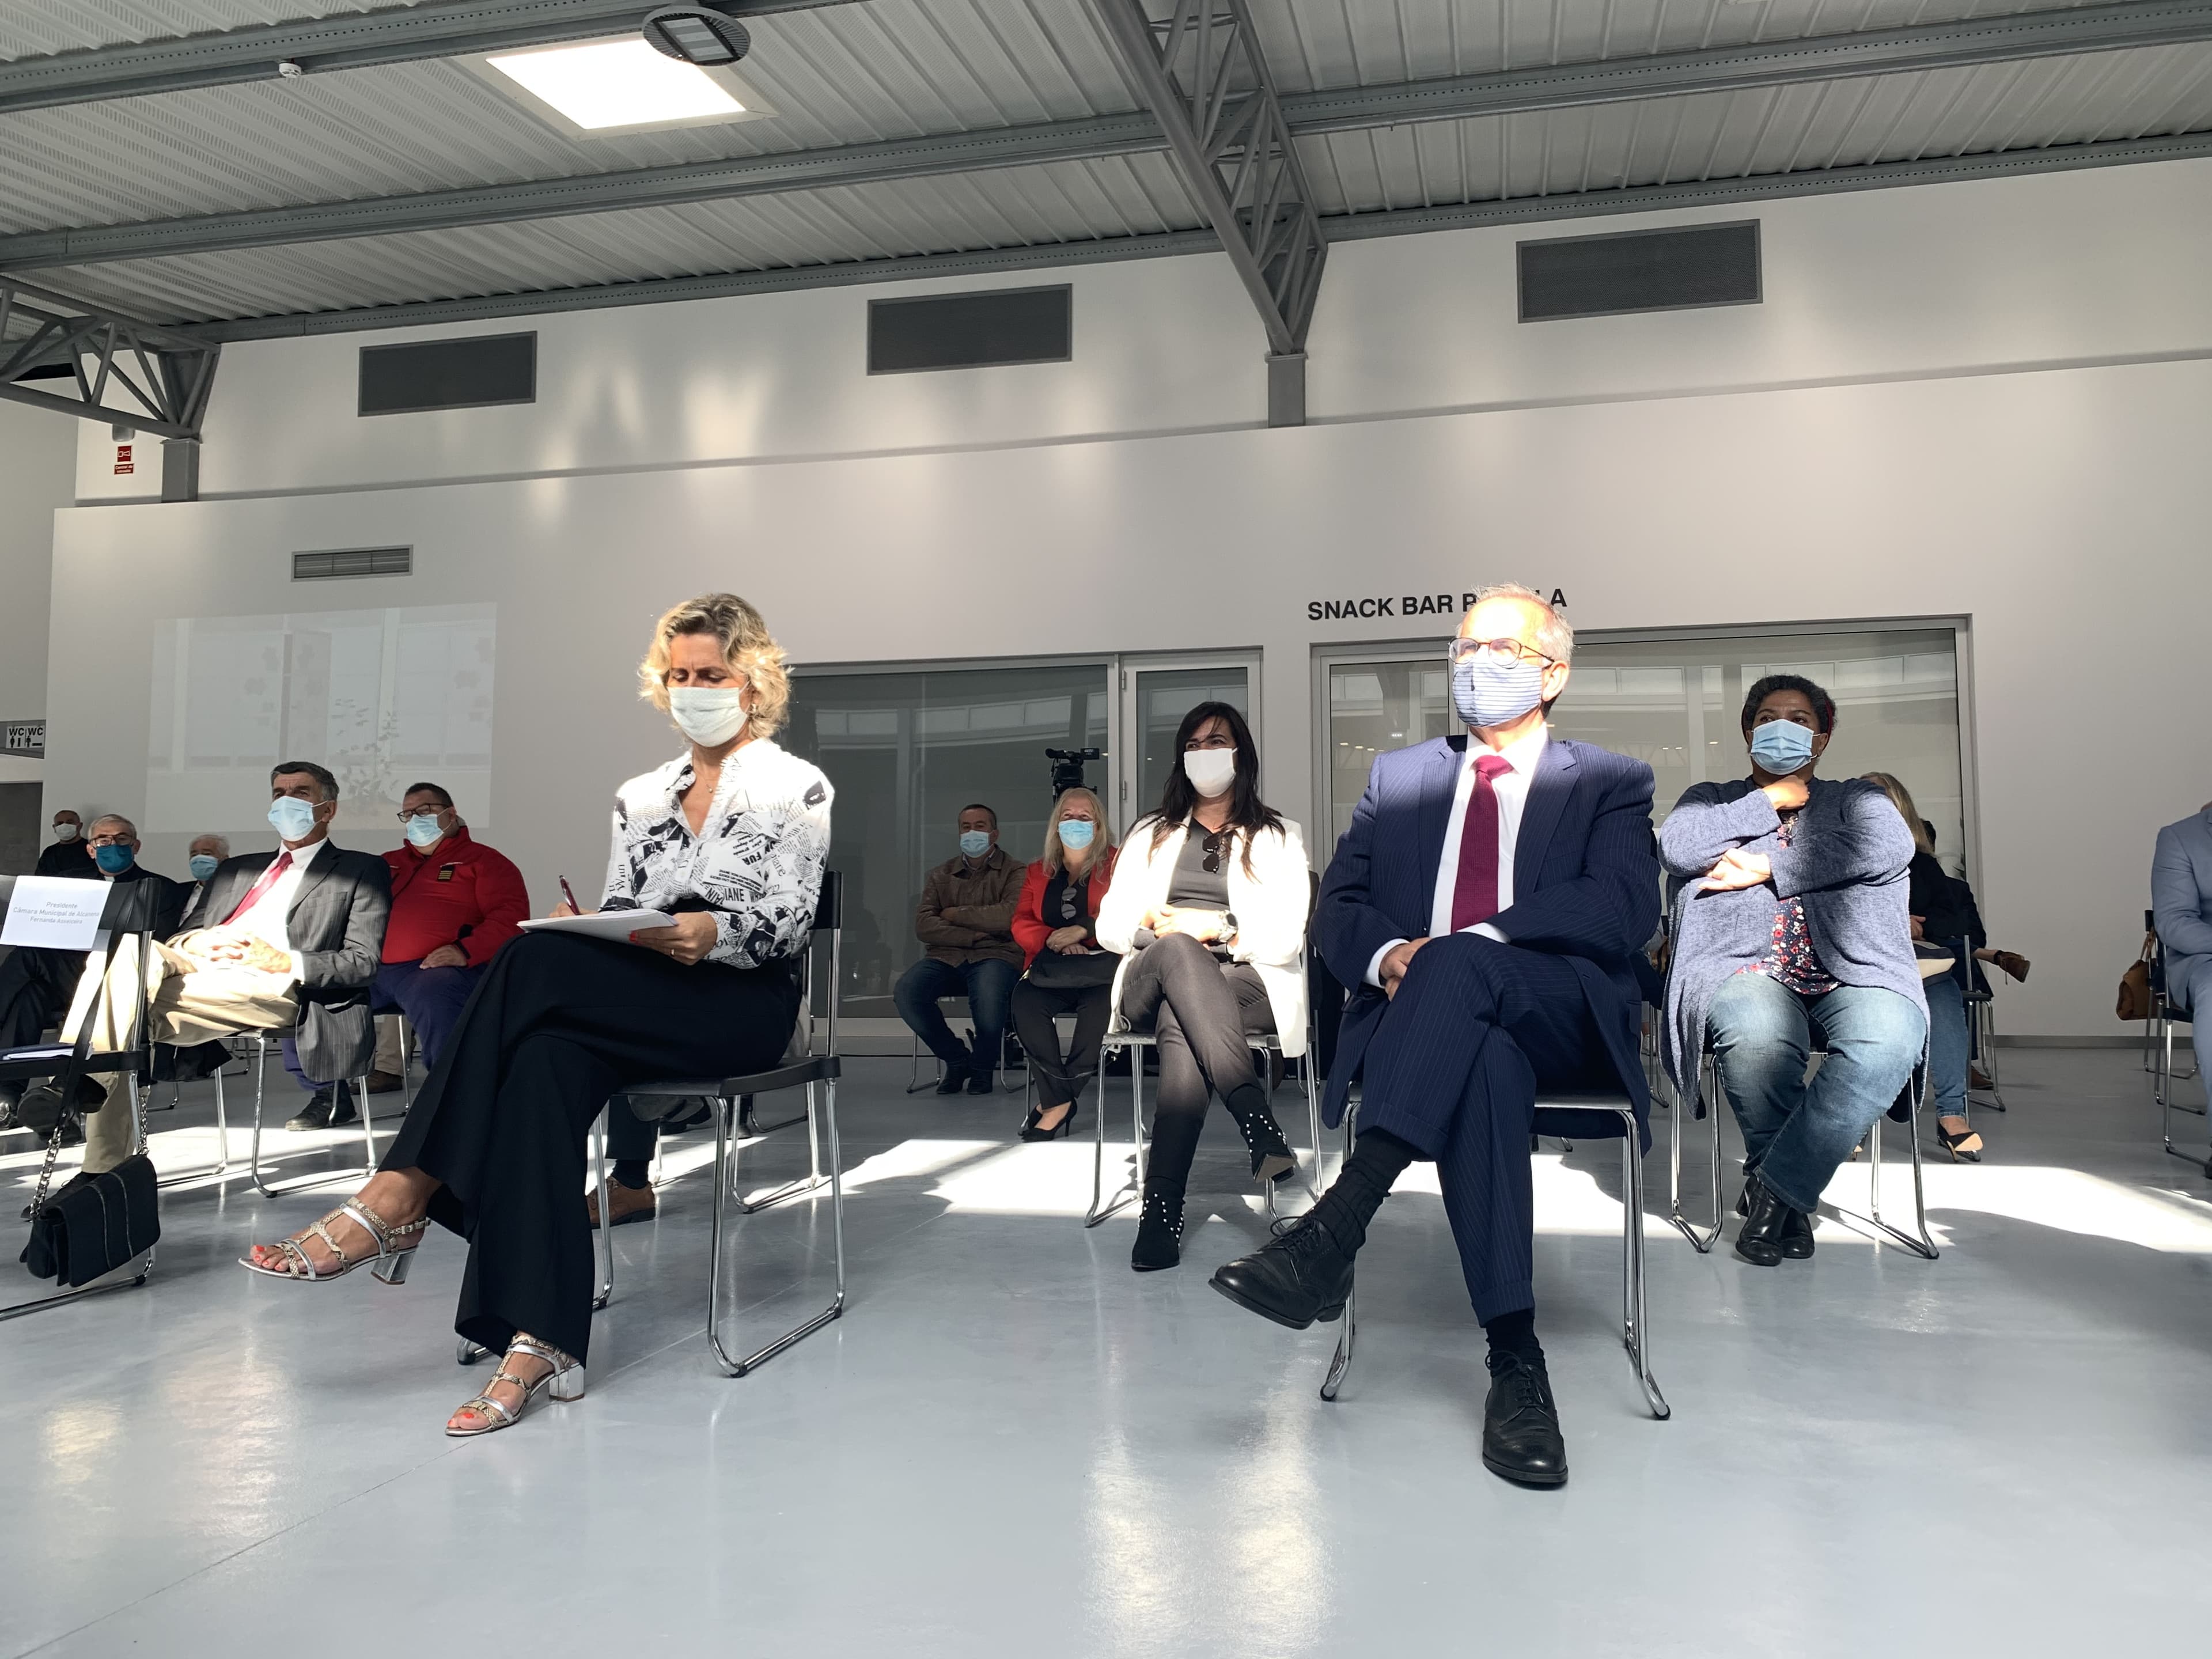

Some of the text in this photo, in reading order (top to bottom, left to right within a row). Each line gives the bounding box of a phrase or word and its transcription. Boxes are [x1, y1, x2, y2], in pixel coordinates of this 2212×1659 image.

[1308, 597, 1395, 620] SNACK
[1402, 594, 1453, 615] BAR
[9, 727, 43, 736] WC WC
[13, 907, 37, 915] Câmara
[39, 909, 67, 917] Municipal
